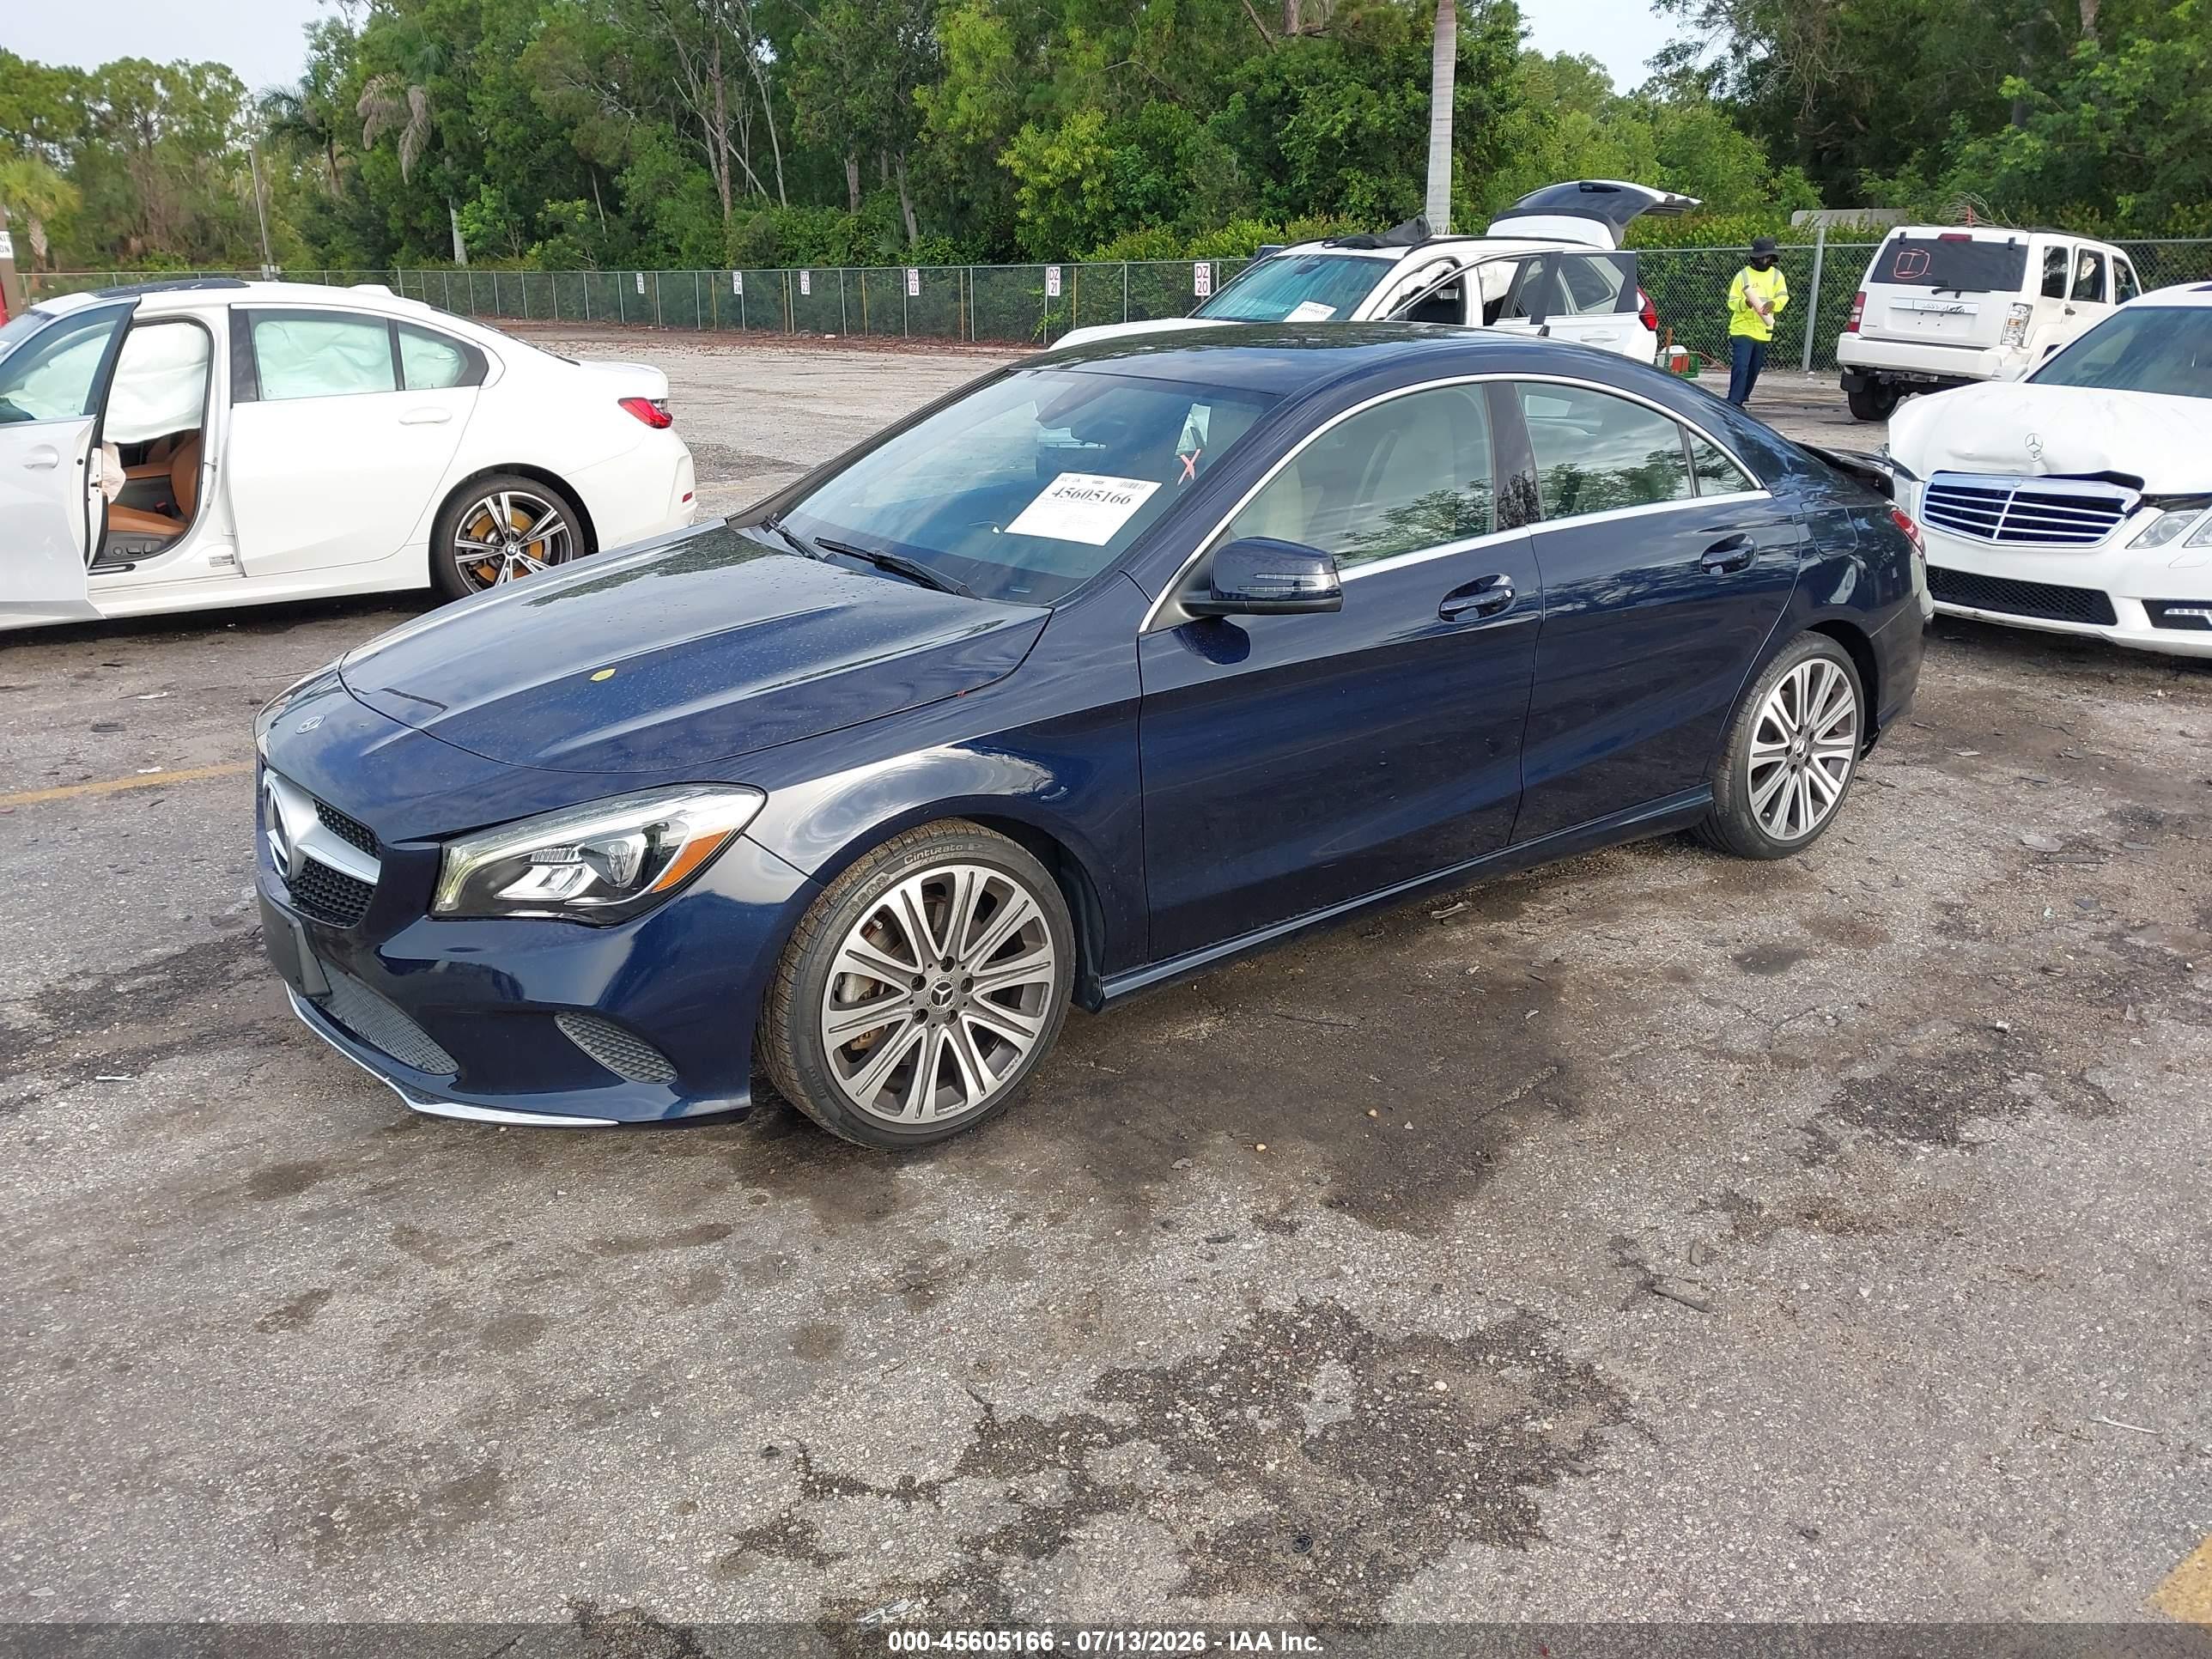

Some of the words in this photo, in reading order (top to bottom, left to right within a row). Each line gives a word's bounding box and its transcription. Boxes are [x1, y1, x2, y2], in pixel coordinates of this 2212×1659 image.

[801, 272, 808, 282] DZ
[909, 272, 918, 282] DZ
[1049, 269, 1059, 281] DZ
[1196, 266, 1209, 278] DZ
[802, 283, 809, 292] 23
[911, 283, 918, 293] 22
[1051, 283, 1058, 293] 21
[1197, 281, 1208, 293] 20
[1052, 487, 1134, 505] 45605166
